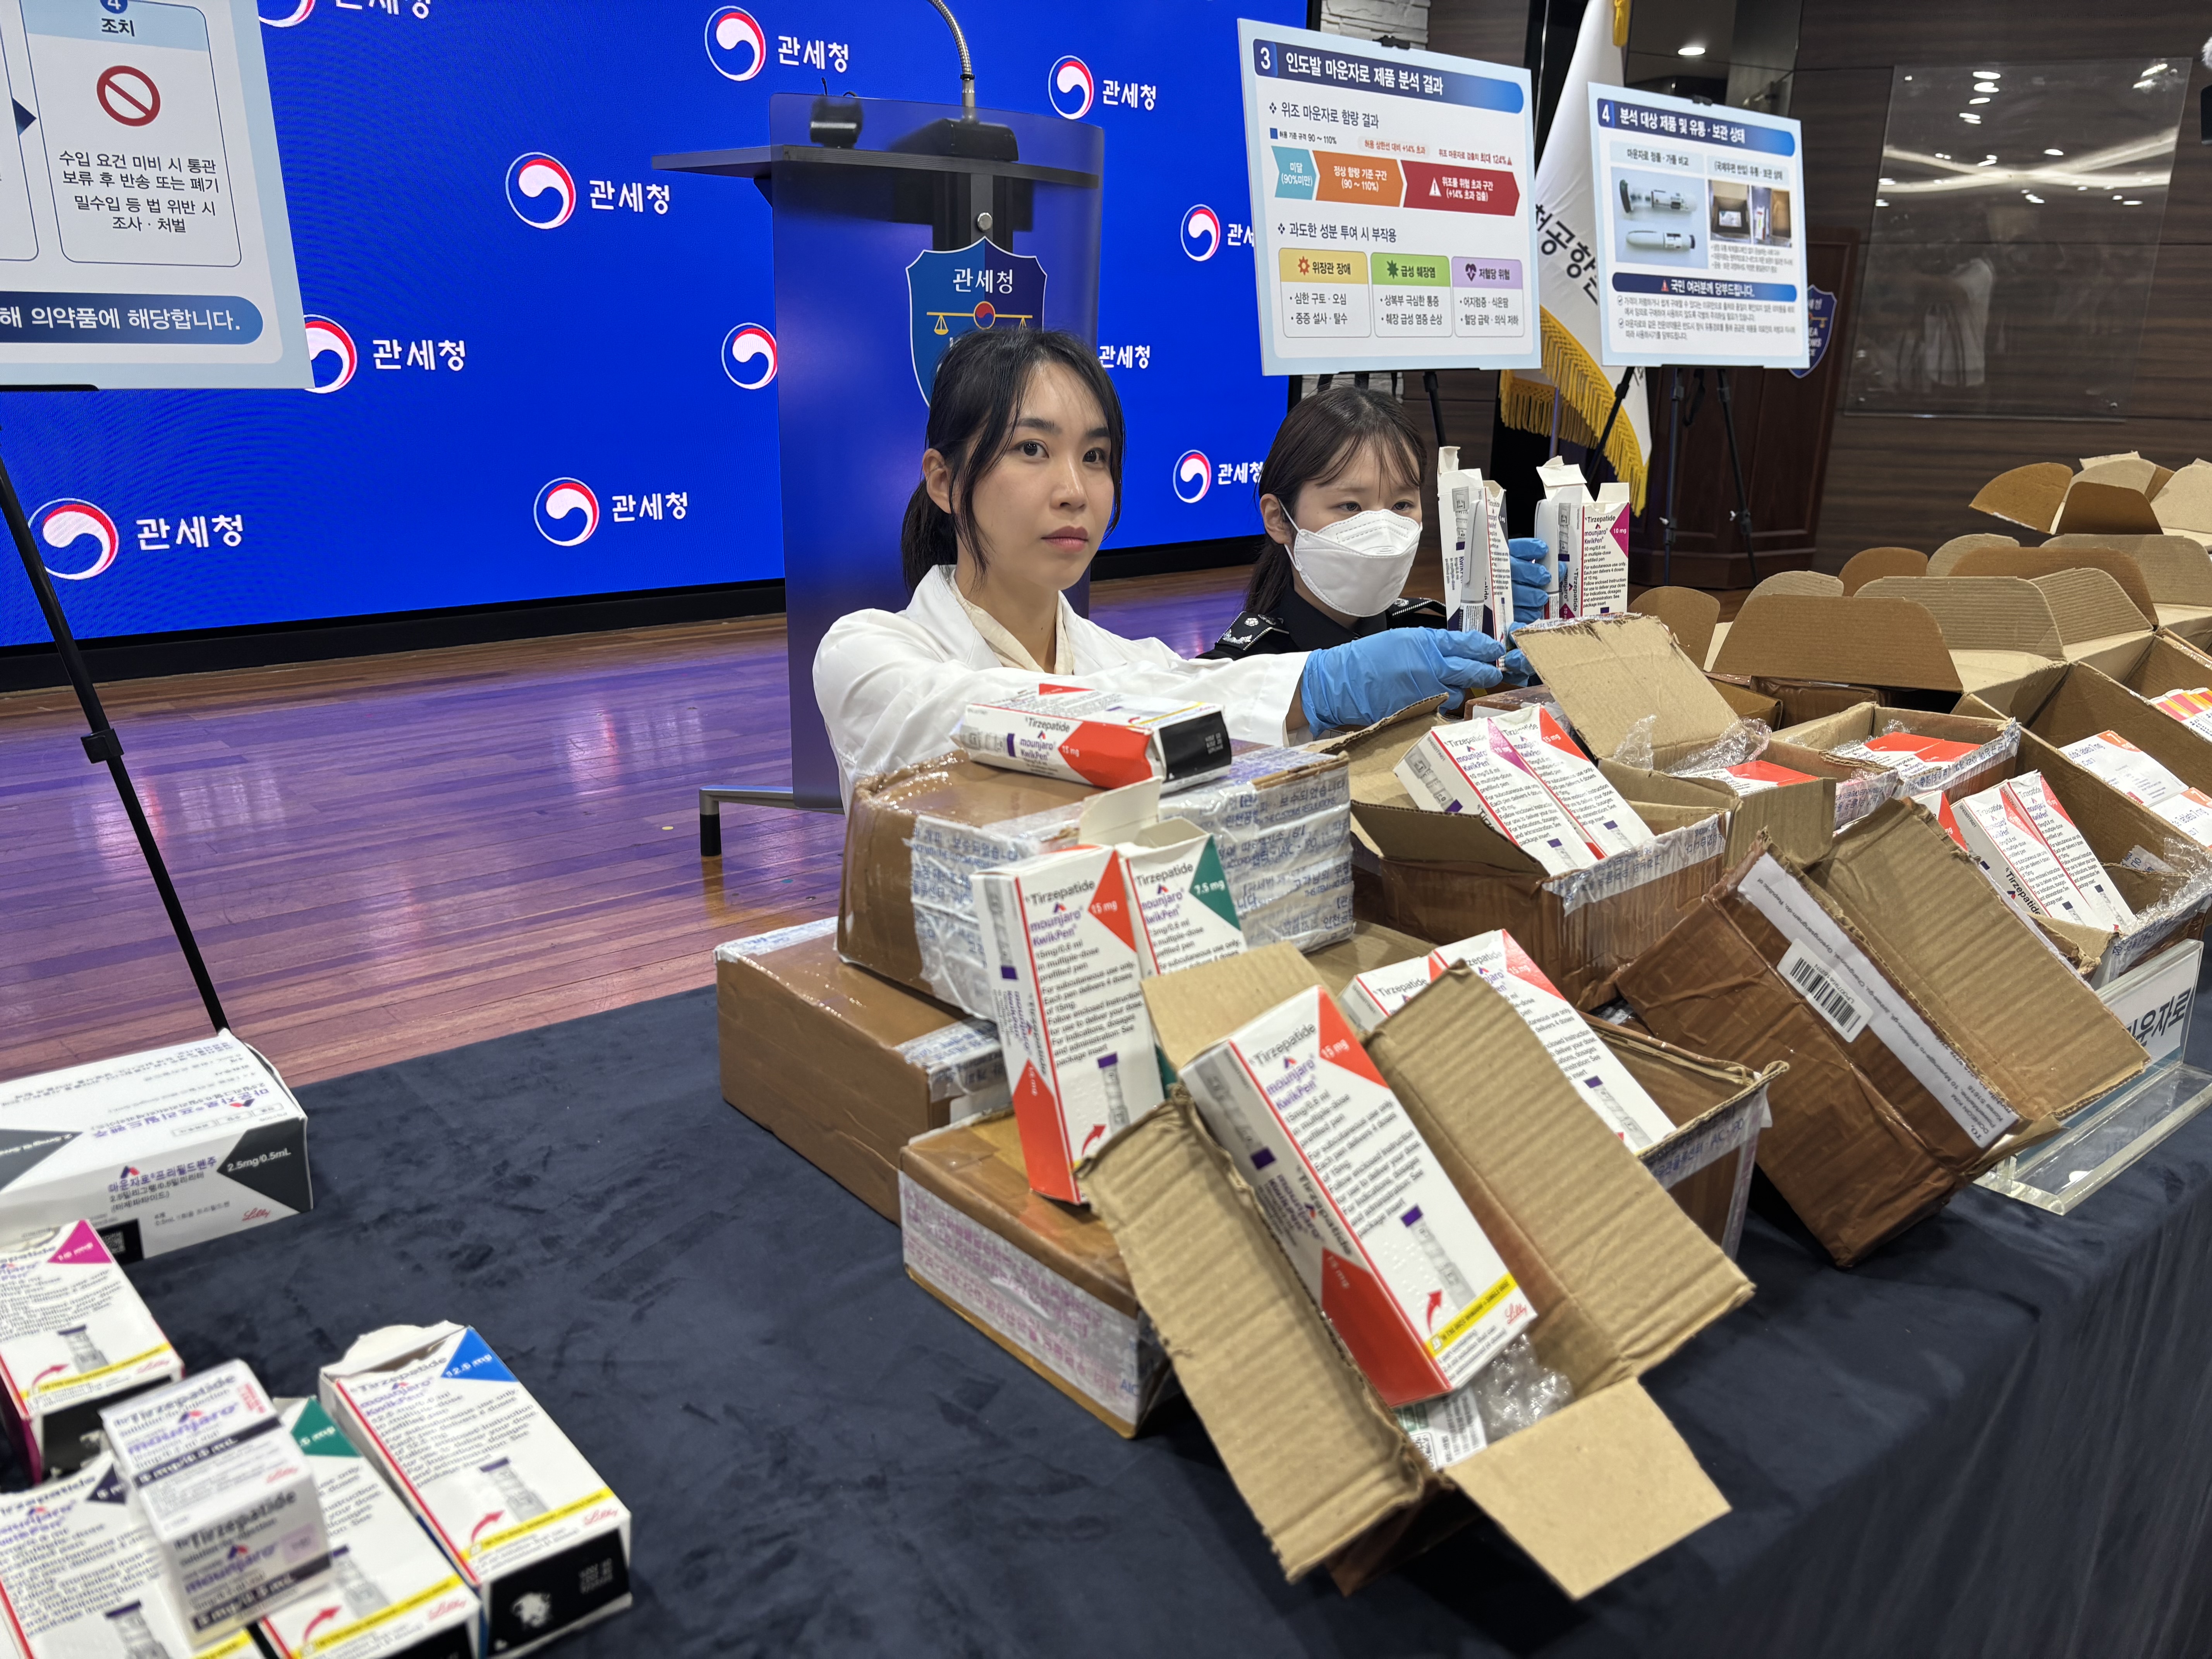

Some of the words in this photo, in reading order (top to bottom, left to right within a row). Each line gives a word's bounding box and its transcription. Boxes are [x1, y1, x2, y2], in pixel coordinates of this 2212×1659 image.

[101, 18, 135, 36] 조치
[778, 35, 849, 73] 관세청
[1260, 47, 1271, 70] 3
[1286, 52, 1321, 77] 인도발
[1326, 59, 1370, 83] 마운자로
[1374, 67, 1395, 88] 제품
[1398, 70, 1420, 92] 분석
[1422, 75, 1443, 95] 결과
[1103, 79, 1156, 111] 관세청
[1281, 102, 1300, 117] 위조
[1303, 105, 1339, 123] 마운자로
[1342, 110, 1358, 126] 함량
[1362, 113, 1379, 129] 결과
[1602, 104, 1610, 122] 4
[1620, 108, 1638, 127] 분석
[1640, 112, 1657, 129] 대상
[1660, 115, 1676, 132] 제품
[1678, 118, 1688, 135] 및
[1690, 120, 1705, 137] 유통
[1712, 124, 1728, 141] 보관
[1730, 127, 1745, 144] 상태
[1308, 134, 1315, 142] 90
[1323, 136, 1337, 144] 110%
[59, 151, 91, 167] 수입
[97, 154, 127, 169] 요건
[133, 156, 161, 171] 미비
[168, 158, 182, 172] 시
[187, 158, 216, 174] 통관
[1290, 162, 1302, 173] 미달
[63, 170, 94, 187] 보류
[100, 172, 115, 187] 후
[120, 173, 150, 189] 반송
[156, 177, 185, 191] 또는
[191, 178, 219, 193] 폐기
[1334, 166, 1346, 177] 정상
[1362, 168, 1373, 179] 기준
[1375, 170, 1387, 181] 구간
[75, 195, 120, 211] 밀수입
[126, 198, 141, 212] 등
[147, 199, 160, 213] 법
[167, 199, 196, 215] 위반
[202, 202, 215, 216] 시
[589, 180, 670, 214] 관세청
[112, 216, 142, 232] 조사
[158, 218, 186, 232] 처벌
[1290, 222, 1317, 238] 과도한
[1320, 224, 1337, 239] 성분
[1340, 225, 1358, 240] 투여
[1361, 227, 1369, 241] 시
[1372, 227, 1396, 243] 부작용
[1312, 262, 1334, 274] 위장관
[1336, 263, 1351, 275] 장애
[1401, 266, 1414, 277] 급성
[953, 268, 1013, 295] 관세청
[1295, 292, 1309, 304] 심한
[1312, 293, 1326, 305] 구토
[1333, 293, 1346, 305] 오심
[1384, 295, 1404, 306] 상복부
[1406, 295, 1425, 307] 극심한
[31, 307, 120, 330] 의약품에
[128, 309, 240, 331] 해당합니다.
[1296, 313, 1310, 325] 중증
[1313, 313, 1327, 325] 설사
[1334, 313, 1348, 325] 탈수
[1401, 314, 1413, 325] 급성
[373, 339, 465, 372] 관세청
[1099, 345, 1151, 369] 관세청
[1218, 463, 1263, 485] 관세청
[612, 493, 688, 521] 관세청
[137, 513, 244, 550] 관세청
[1210, 880, 1225, 891] mg
[1091, 903, 1103, 914] 15
[1104, 901, 1118, 912] mg
[1335, 1039, 1350, 1053] mg
